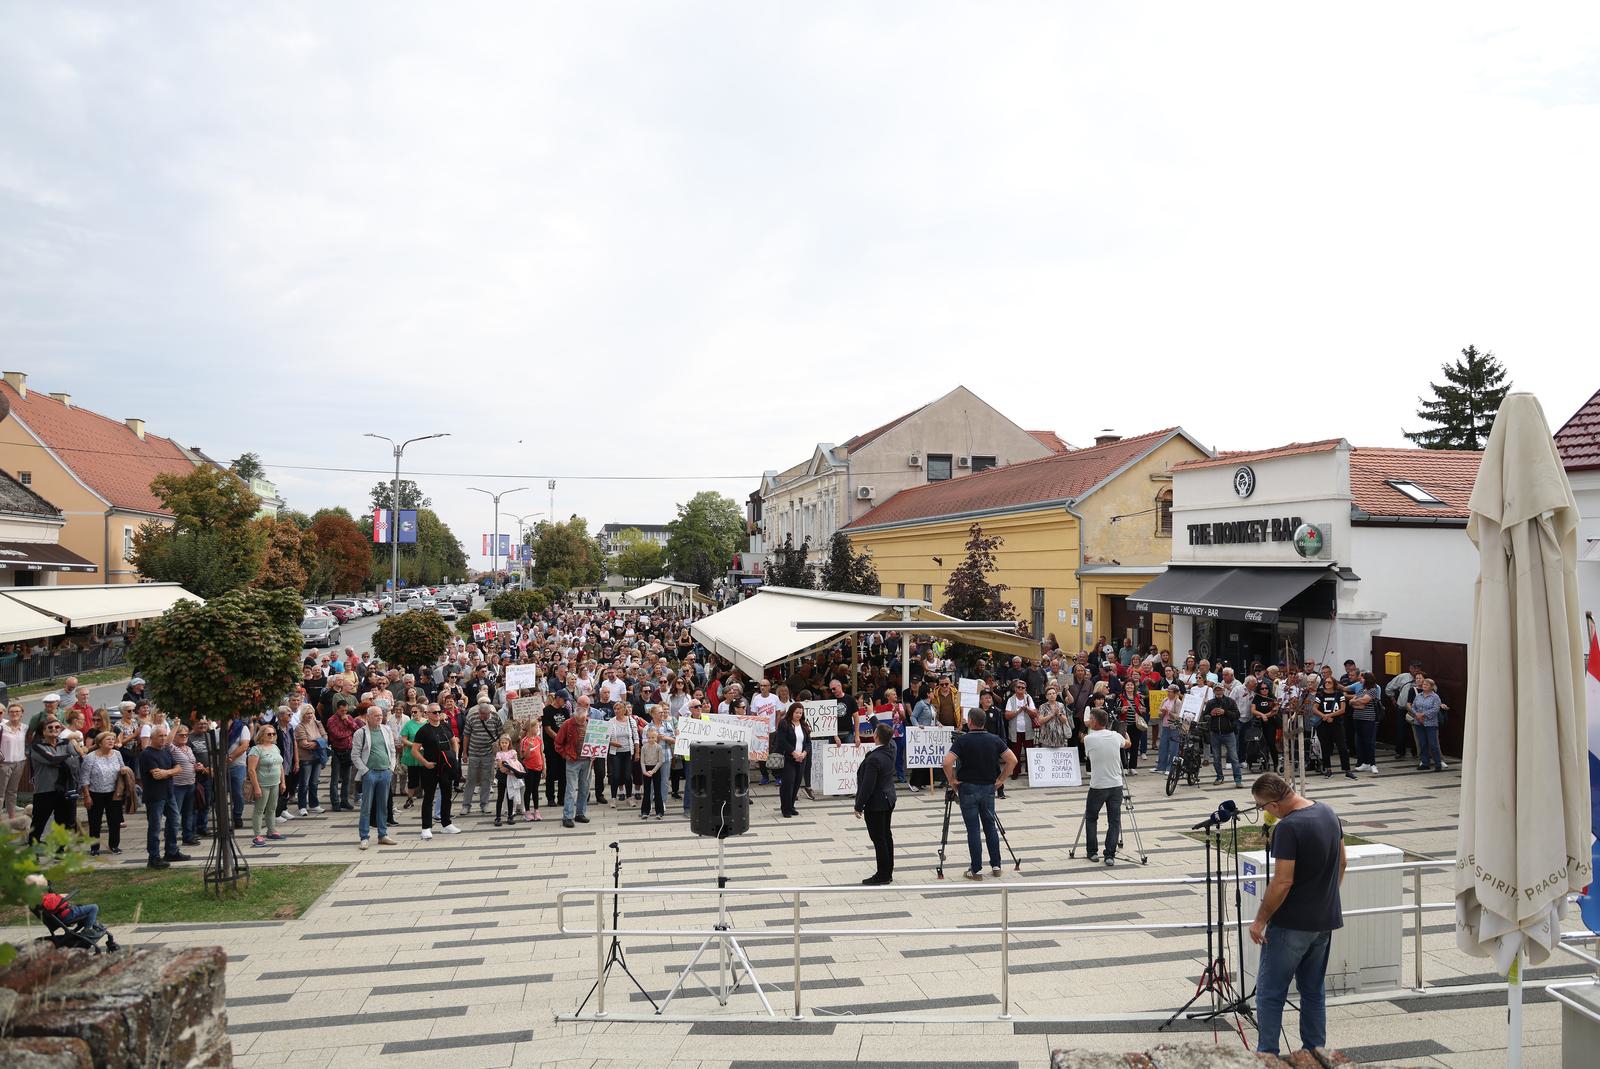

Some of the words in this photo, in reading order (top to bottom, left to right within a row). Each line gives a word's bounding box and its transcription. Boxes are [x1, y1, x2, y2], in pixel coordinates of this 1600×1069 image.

[1187, 524, 1211, 545] THE
[1212, 520, 1268, 544] MONKEY
[1170, 605, 1180, 614] THE
[1183, 606, 1204, 616] MONKEY
[1207, 608, 1219, 617] BAR
[838, 778, 857, 790] ZRA
[1525, 867, 1567, 900] PRAGU
